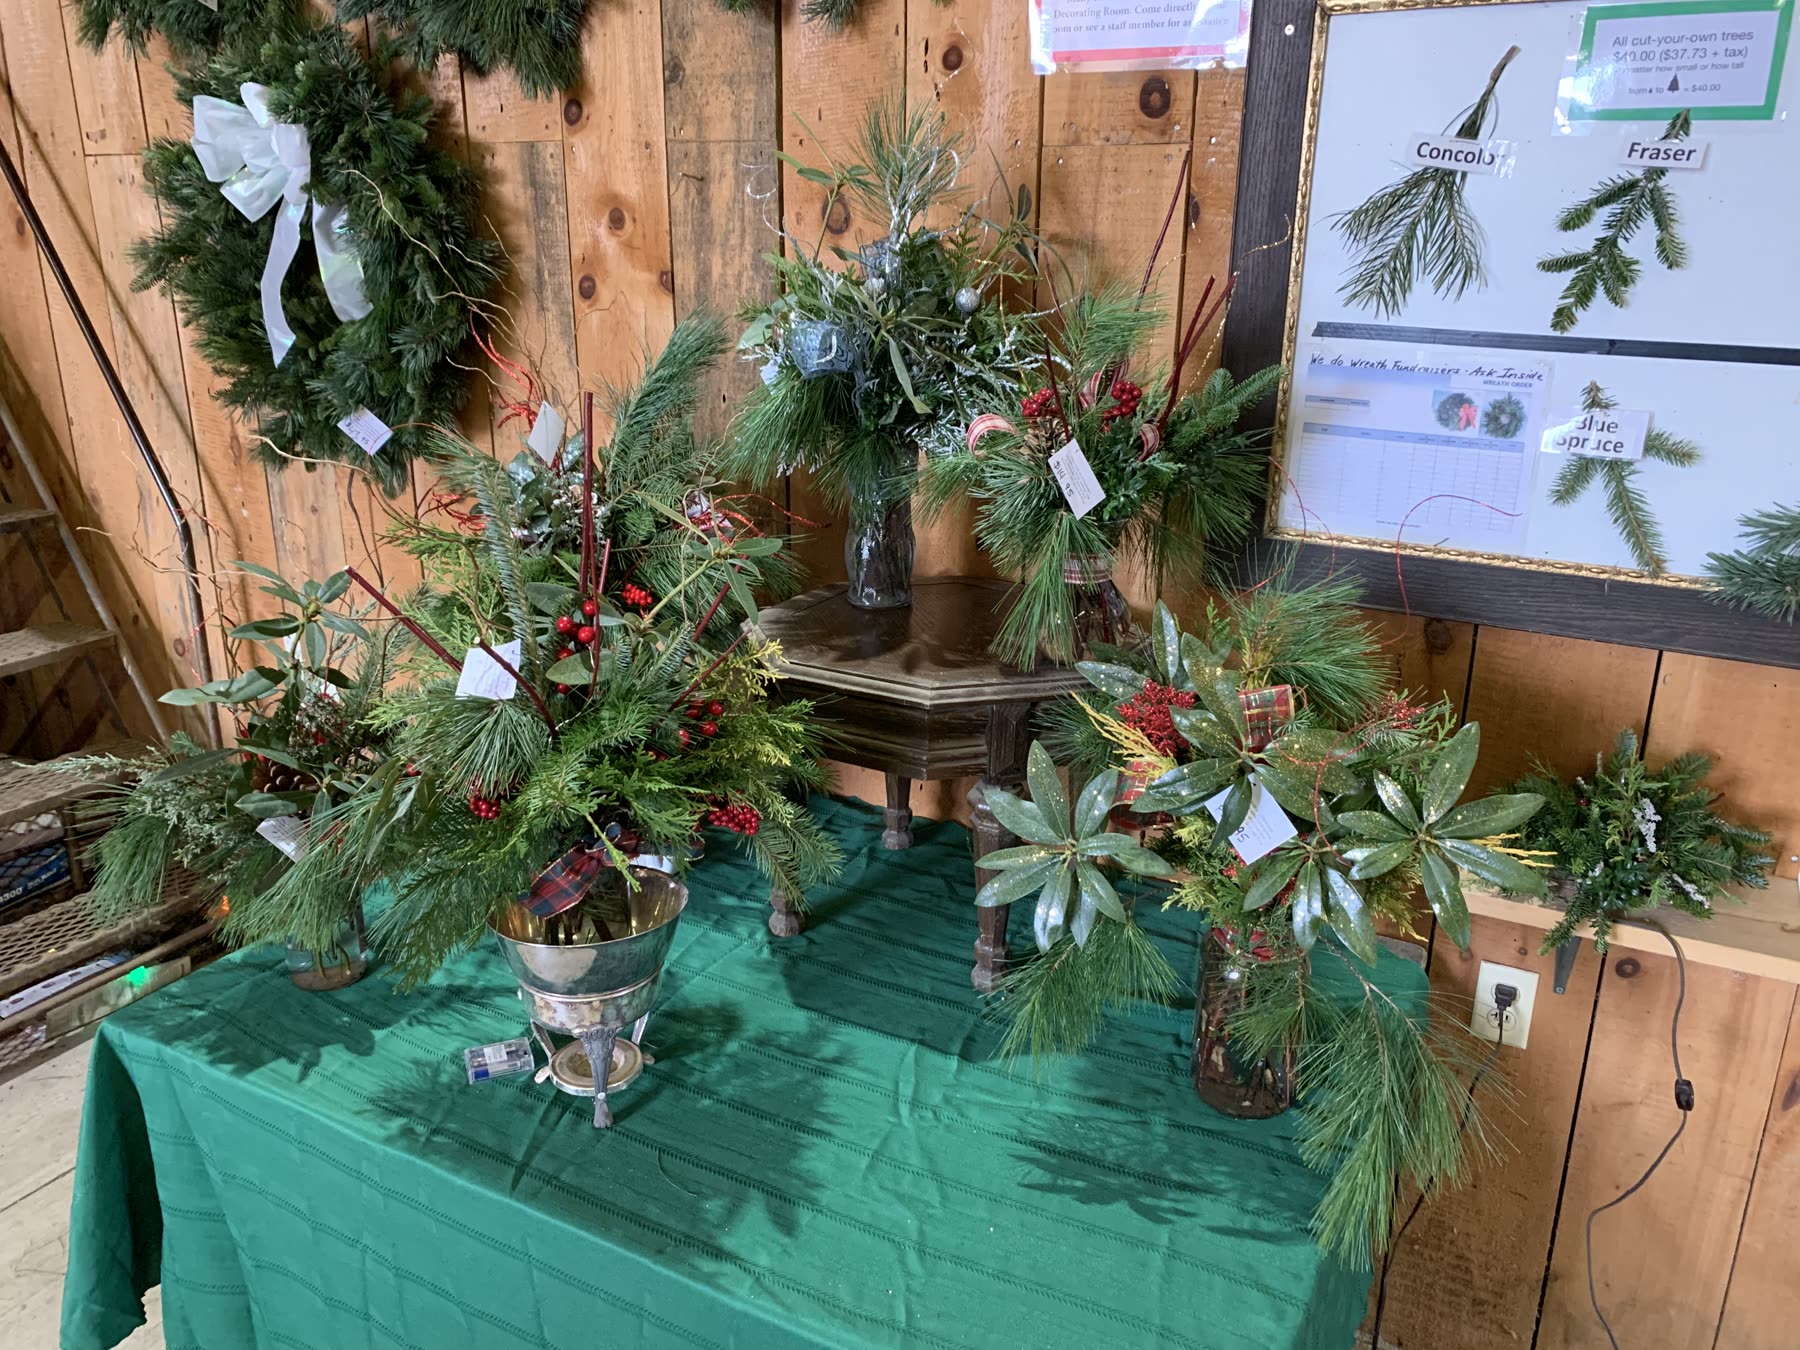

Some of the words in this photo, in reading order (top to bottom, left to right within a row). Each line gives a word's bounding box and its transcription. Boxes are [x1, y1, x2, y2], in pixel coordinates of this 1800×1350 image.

[1053, 7, 1101, 19] Decorating
[1134, 4, 1160, 14] Come
[1085, 24, 1098, 32] see
[1107, 21, 1127, 31] staff
[1128, 19, 1165, 30] member
[1167, 18, 1181, 28] for
[1612, 35, 1628, 47] All
[1631, 32, 1717, 47] cut-your-own
[1721, 30, 1754, 41] trees
[1612, 49, 1656, 64] $40.00
[1659, 47, 1708, 63] ($37.73
[1724, 46, 1749, 58] tax)
[1655, 64, 1673, 72] how
[1675, 63, 1698, 72] small
[1710, 62, 1729, 70] how
[1731, 61, 1745, 69] tall
[1655, 86, 1664, 94] to
[1627, 142, 1697, 162] Fraser
[1310, 353, 1324, 365] We
[1330, 354, 1344, 366] do
[1392, 360, 1461, 375] Fundraisers
[1468, 366, 1498, 377] Ask
[1497, 367, 1544, 382] Inside
[1483, 379, 1510, 387] WREATH
[1511, 381, 1533, 389] ORDER
